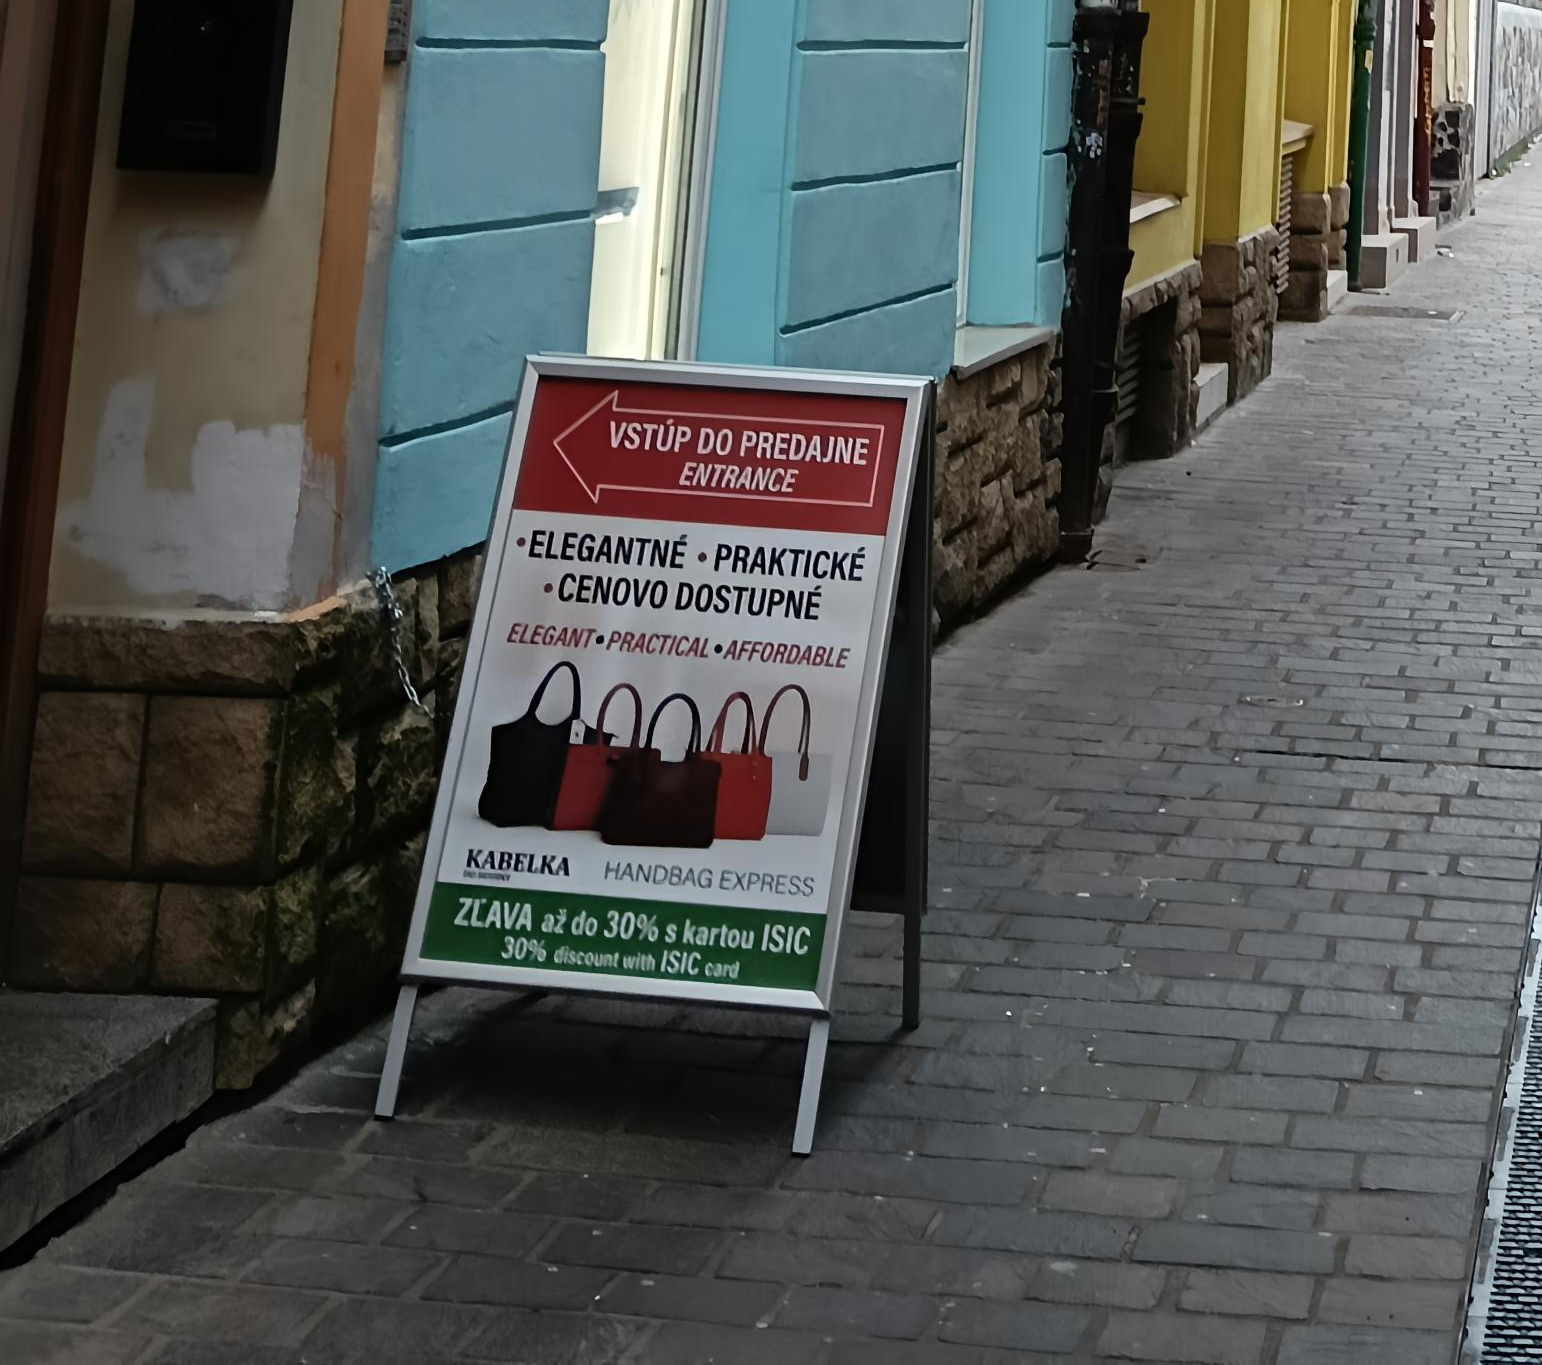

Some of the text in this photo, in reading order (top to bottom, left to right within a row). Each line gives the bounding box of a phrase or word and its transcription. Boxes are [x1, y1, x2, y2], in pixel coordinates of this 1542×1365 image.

[609, 418, 870, 466] VSTÚP DO PREDAJNE
[678, 462, 799, 493] ENTRANCE
[528, 530, 866, 582] ELEGANTNÉ PRAKTICKÉ
[558, 573, 822, 621] CENOVO DOSTUPNÉ
[466, 849, 570, 877] KABELKA
[603, 861, 713, 889] HANDBAG
[719, 870, 815, 897] EXPRESS
[454, 897, 811, 956] ZĽAVA až do 30% s kartou ISIC
[501, 936, 740, 979] 30% discount with ISIC card
